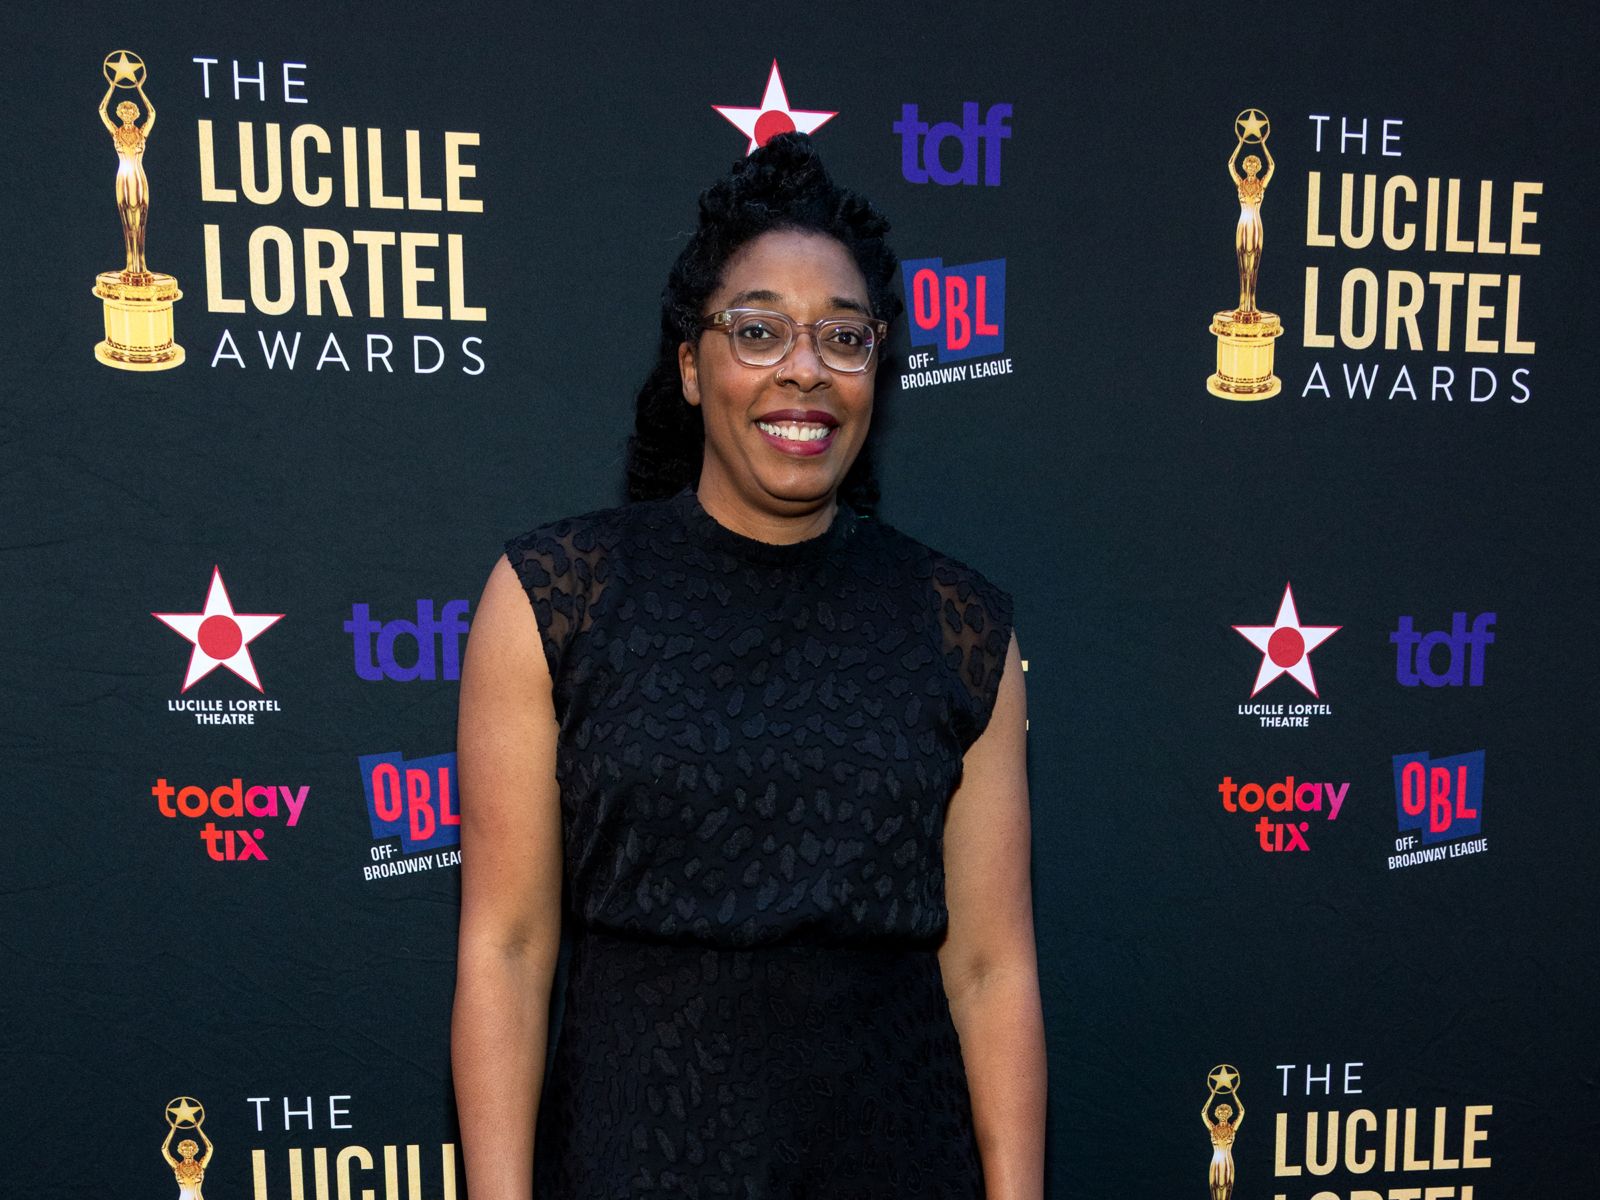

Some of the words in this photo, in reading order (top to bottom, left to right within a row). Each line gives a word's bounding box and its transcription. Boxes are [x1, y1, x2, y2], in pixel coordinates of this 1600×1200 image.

[193, 58, 308, 103] THE
[893, 102, 1012, 185] tdf
[1309, 115, 1402, 156] THE
[198, 120, 483, 212] LUCILLE
[1307, 172, 1543, 255] LUCILLE
[204, 224, 486, 321] LORTEL
[913, 269, 998, 350] OBL
[1303, 267, 1535, 354] LORTEL
[212, 329, 484, 375] AWARDS
[909, 353, 934, 370] OFF-
[901, 369, 967, 389] BROADWAY
[970, 359, 1012, 378] LEAGUE
[1302, 362, 1529, 403] AWARDS
[344, 600, 469, 681] tdf
[1391, 612, 1496, 687] tdf
[168, 700, 222, 711] LUCILLE
[229, 700, 280, 711] LORTEL
[195, 714, 254, 724] THEATRE
[1239, 705, 1283, 714] LUCILLE
[1289, 705, 1331, 714] LORTEL
[1260, 717, 1308, 727] THEATRE
[152, 779, 310, 826] today
[372, 763, 461, 840] OBL
[1218, 776, 1350, 820] today
[1402, 762, 1476, 832] OBL
[201, 823, 267, 860] tix
[370, 844, 398, 861] OFF-
[1256, 817, 1309, 851] tix
[1388, 847, 1447, 870] BROADWAY
[1450, 839, 1487, 857] LEAGUE
[1396, 836, 1418, 851] OFF-
[363, 856, 433, 880] BROADWAY
[436, 850, 461, 867] LEA
[1276, 1063, 1363, 1096] THE
[247, 1095, 352, 1131] THE
[1275, 1105, 1492, 1176] LUCILLE
